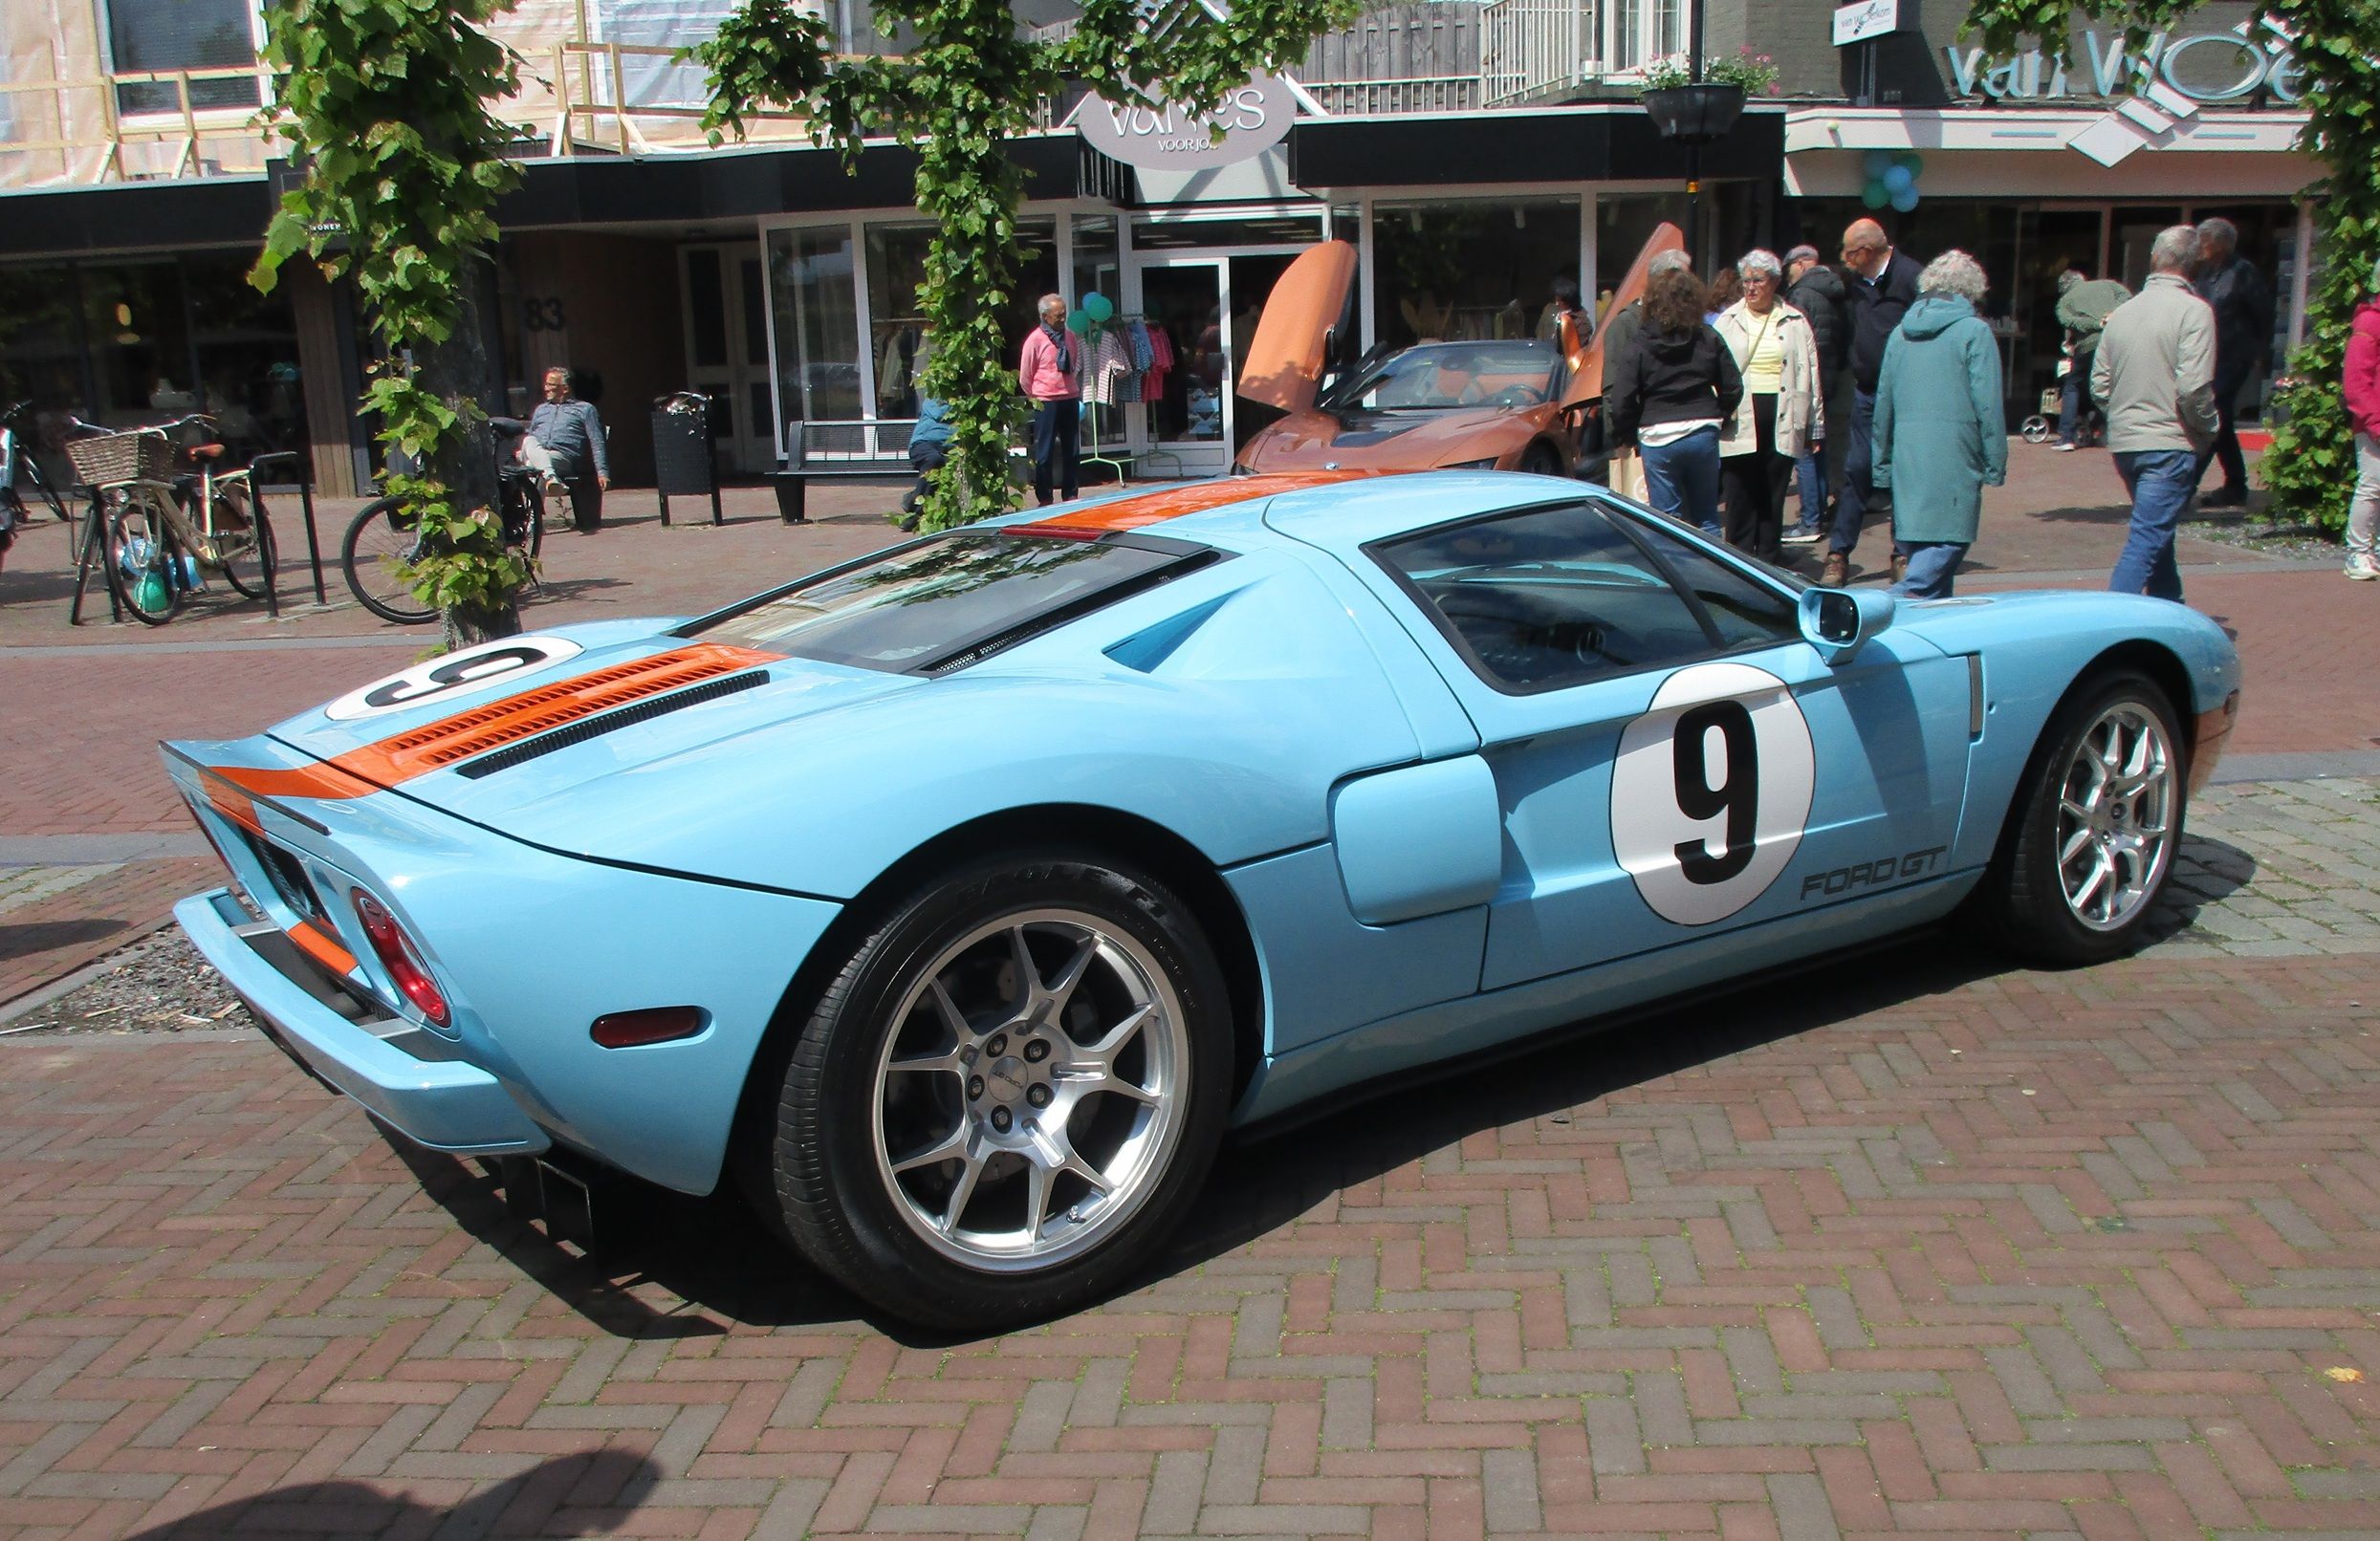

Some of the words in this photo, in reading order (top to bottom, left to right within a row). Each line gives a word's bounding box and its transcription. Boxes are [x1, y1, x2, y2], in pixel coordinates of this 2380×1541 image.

[1157, 138, 1194, 152] VOOR
[1195, 137, 1218, 153] JO
[525, 295, 566, 332] 83
[1672, 699, 1760, 885] 9
[1800, 857, 1897, 901] FORD
[1899, 845, 1948, 879] GT
